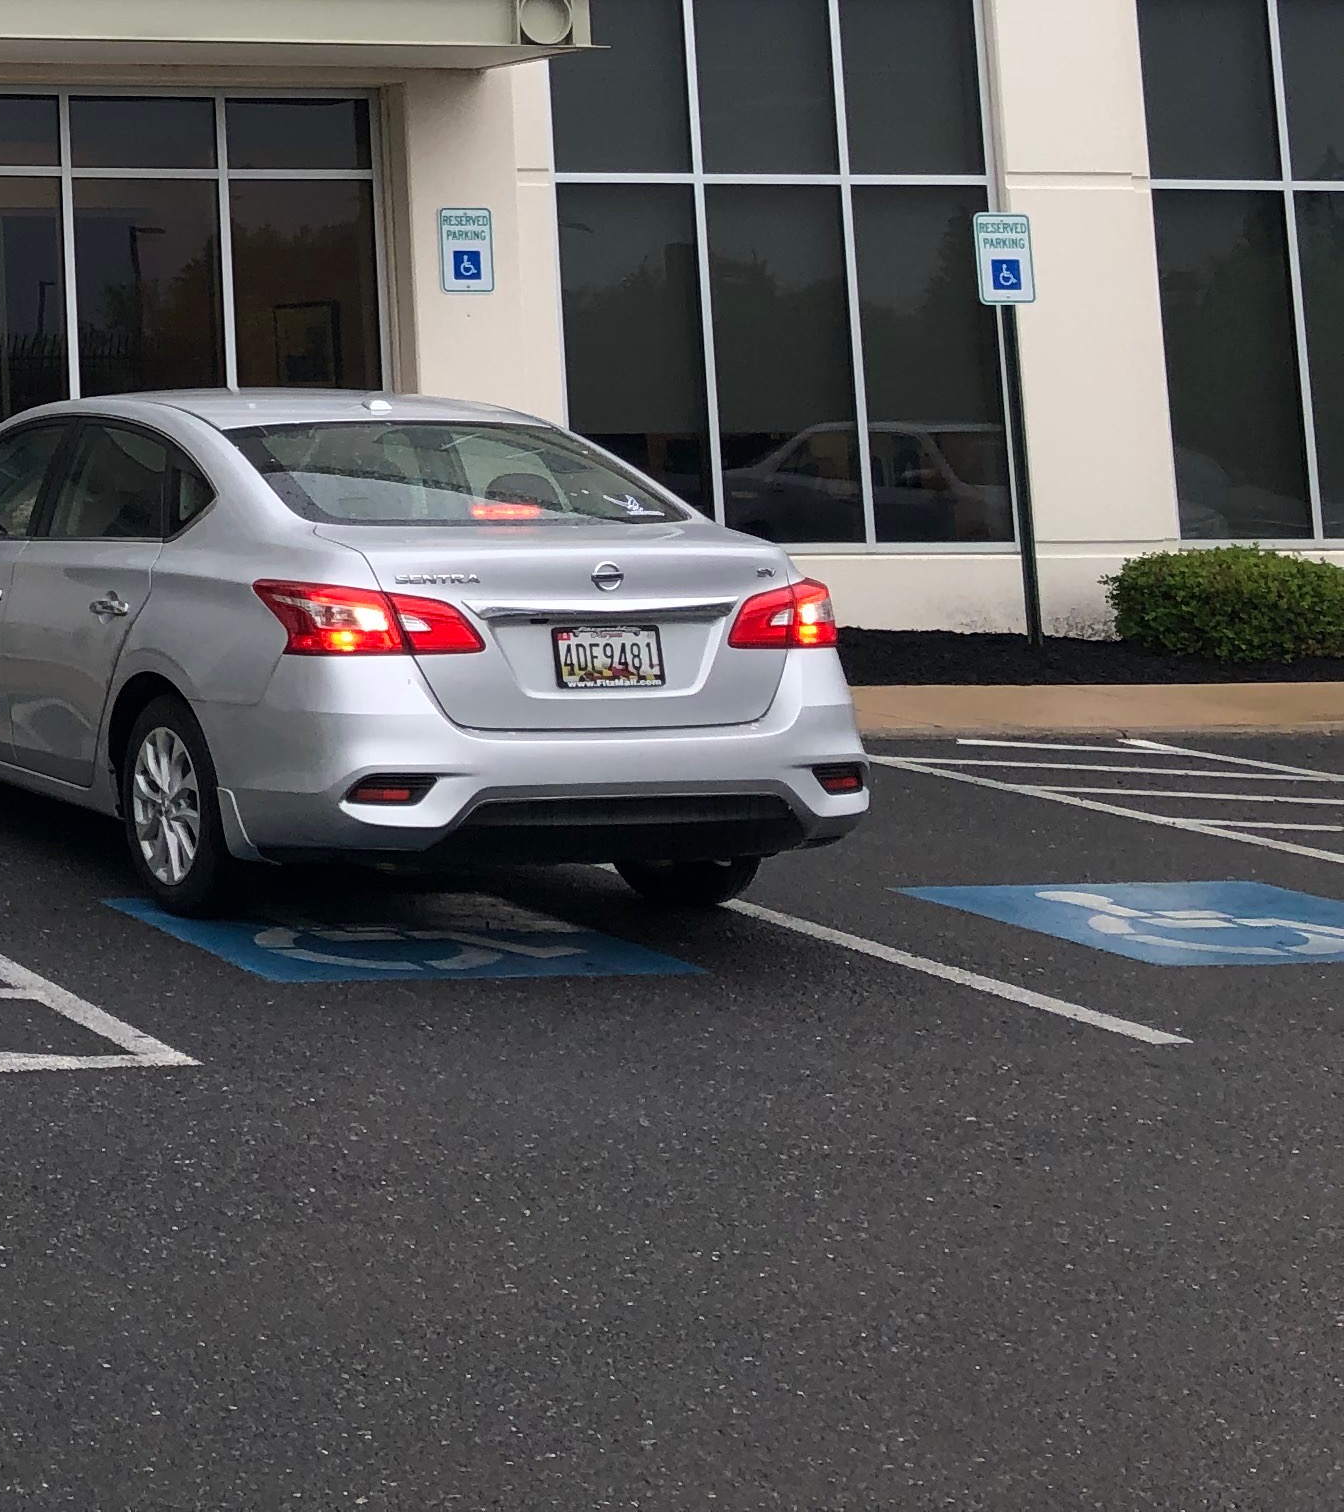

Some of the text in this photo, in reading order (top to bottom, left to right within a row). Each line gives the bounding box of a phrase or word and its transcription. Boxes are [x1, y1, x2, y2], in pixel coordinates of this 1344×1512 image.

[442, 215, 489, 227] RESERVED
[978, 222, 1027, 234] RESERVED
[446, 229, 487, 241] PARKING
[983, 237, 1026, 250] PARKING
[756, 567, 777, 578] SV
[394, 573, 481, 585] SENTRA
